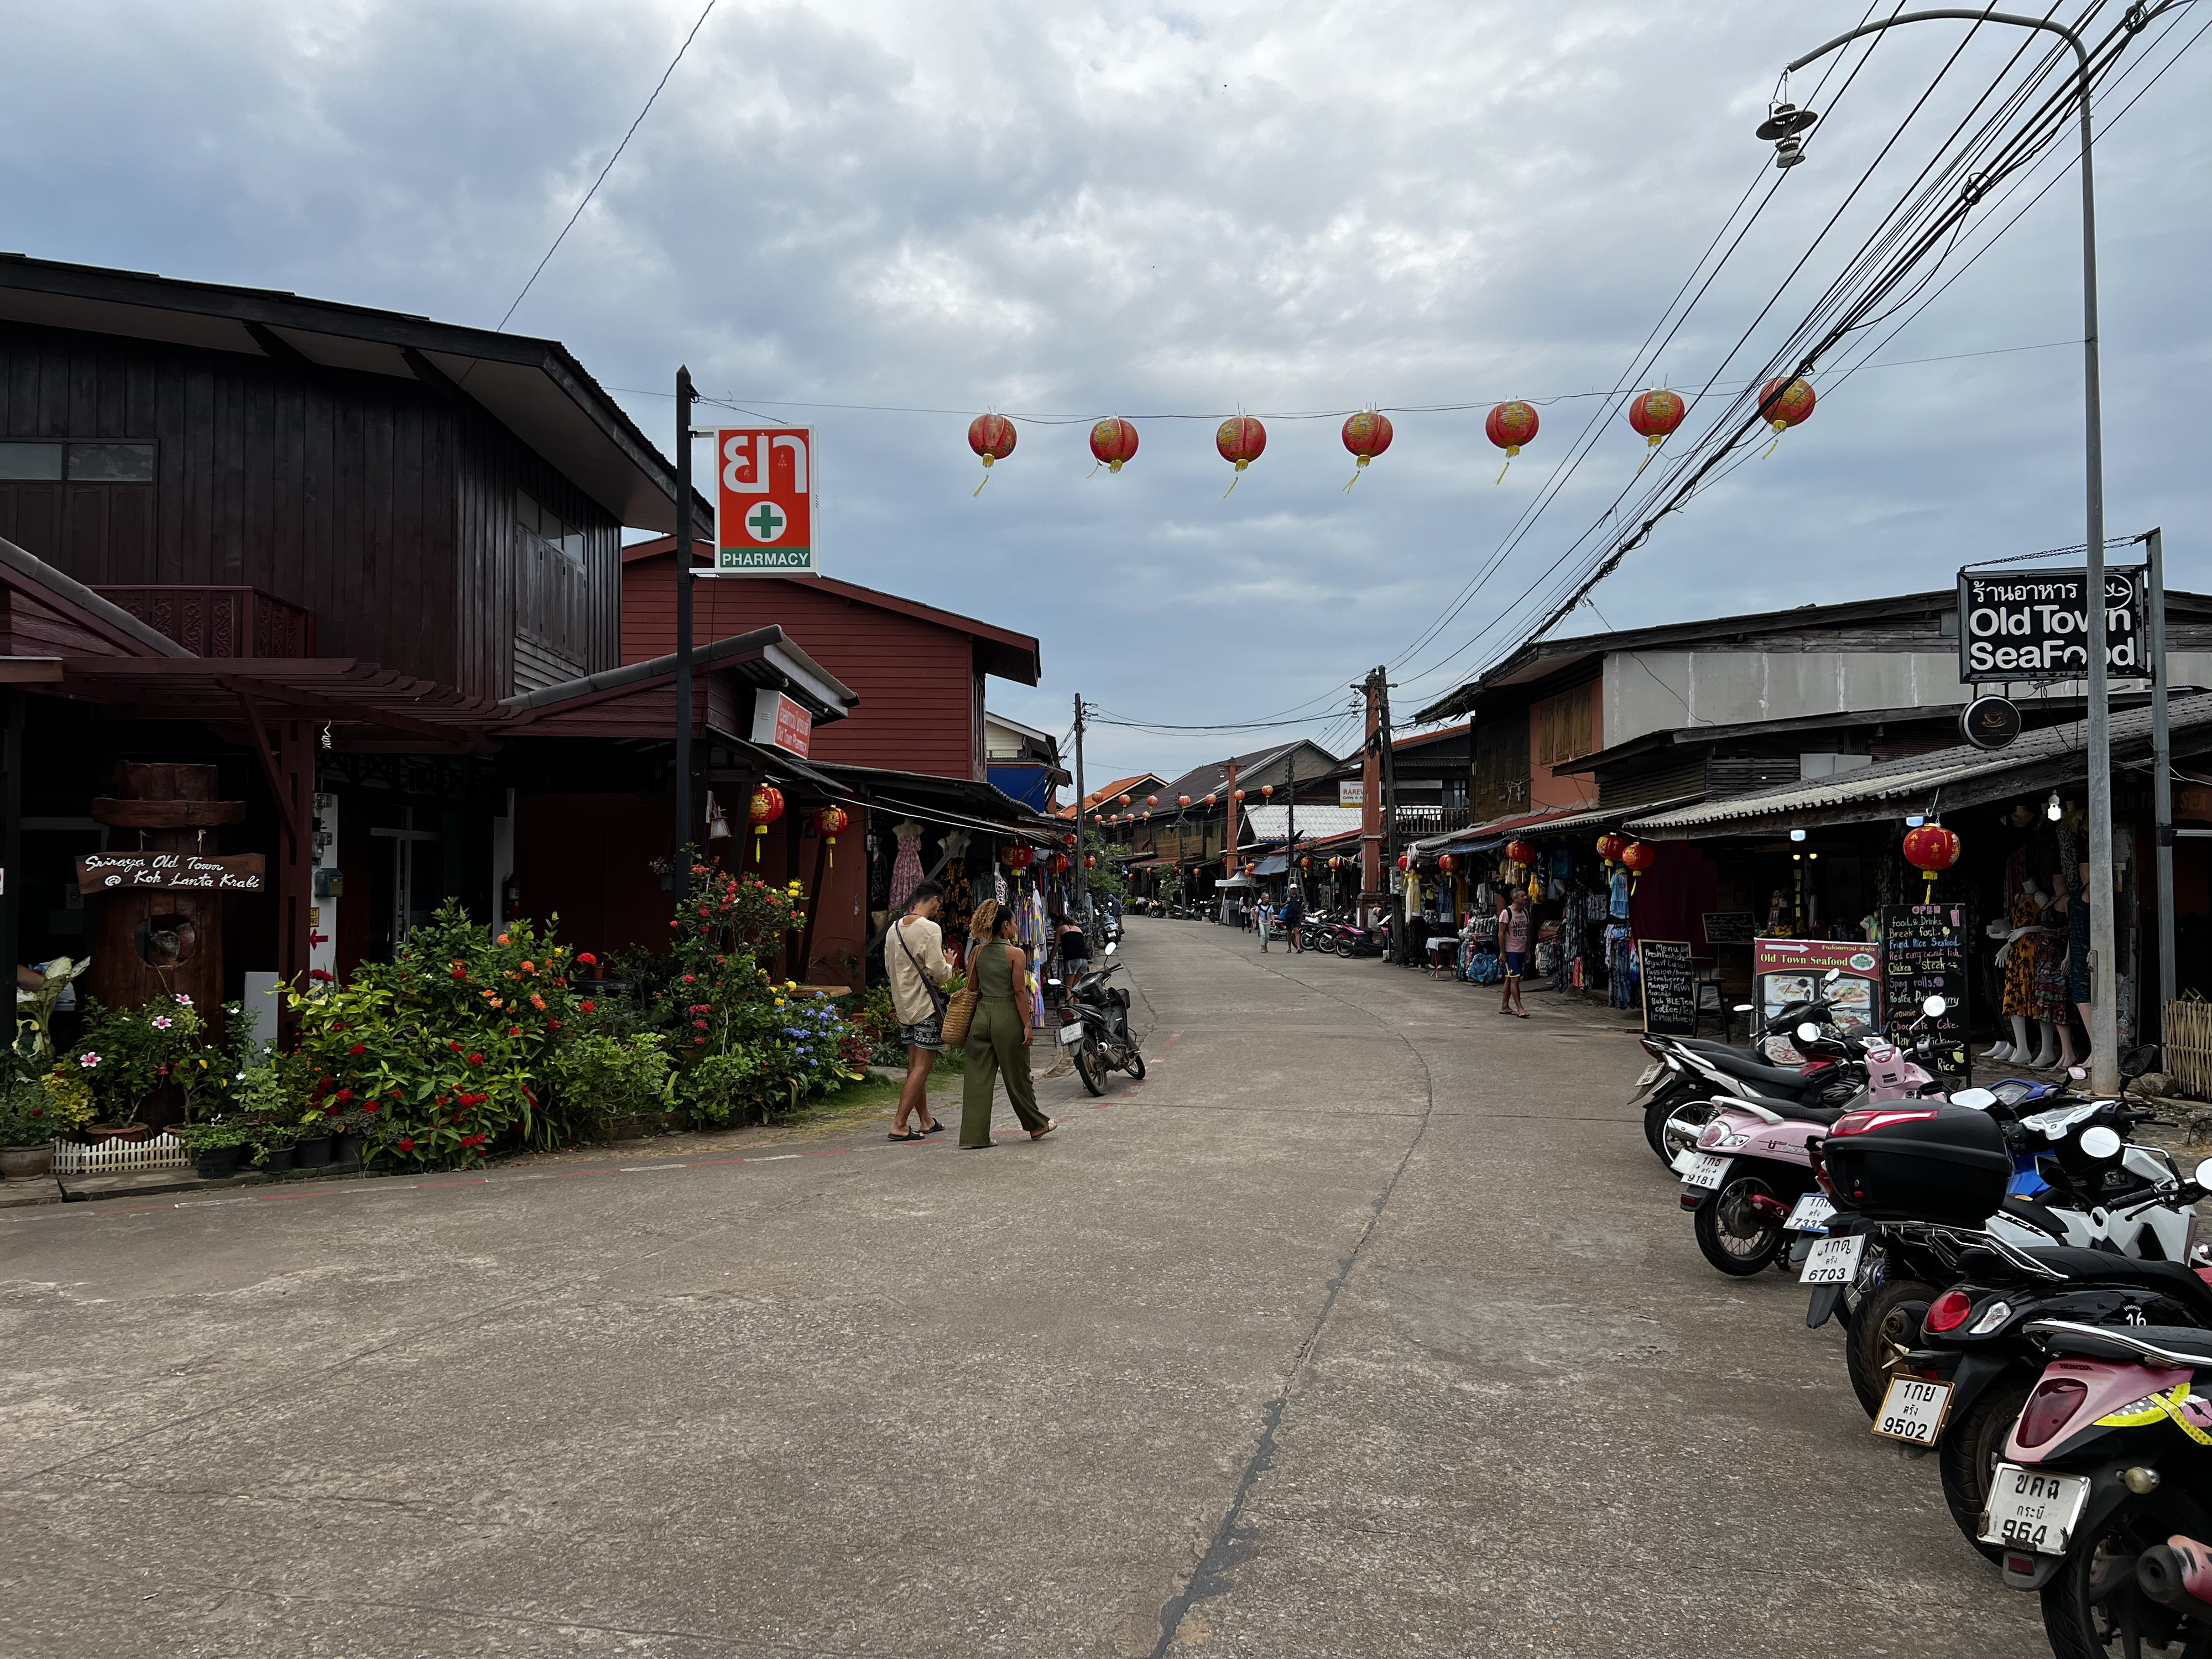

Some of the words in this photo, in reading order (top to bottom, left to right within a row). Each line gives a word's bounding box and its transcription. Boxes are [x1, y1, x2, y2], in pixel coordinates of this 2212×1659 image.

[723, 435, 807, 494] ยา
[722, 553, 808, 566] PHARMACY
[1973, 581, 2078, 603] ร้านอาหาร
[1969, 606, 2031, 637] Old
[1970, 637, 2135, 670] SeaFod
[152, 855, 180, 868] Old
[186, 856, 224, 871] Town
[105, 875, 122, 886] @
[133, 870, 162, 884] Koh
[168, 872, 214, 887] Lanta
[218, 873, 260, 888] Krabi
[1912, 905, 1941, 915] OPEN
[1887, 927, 1914, 939] Break
[1656, 943, 1679, 953] Menu
[1889, 938, 1910, 950] Fried
[1913, 938, 1927, 948] Rice
[1760, 953, 1777, 963] Old
[1780, 954, 1807, 964] Town
[1810, 955, 1849, 967] Seafood
[1889, 950, 1903, 961] Red
[1888, 961, 1912, 974] Chicken
[1893, 1008, 1916, 1018] rownie
[1937, 1057, 1956, 1072] Rice
[1687, 1174, 1715, 1187] 9181
[1825, 1255, 1838, 1265] ตรัง
[1808, 1267, 1846, 1281] 6703
[2126, 1311, 2147, 1326] 16
[2059, 1363, 2094, 1371] HONDA
[1903, 1383, 1937, 1402] 1กย
[1903, 1404, 1919, 1416] ตรัง
[1883, 1416, 1928, 1440] 9502
[2001, 1519, 2048, 1545] 964
